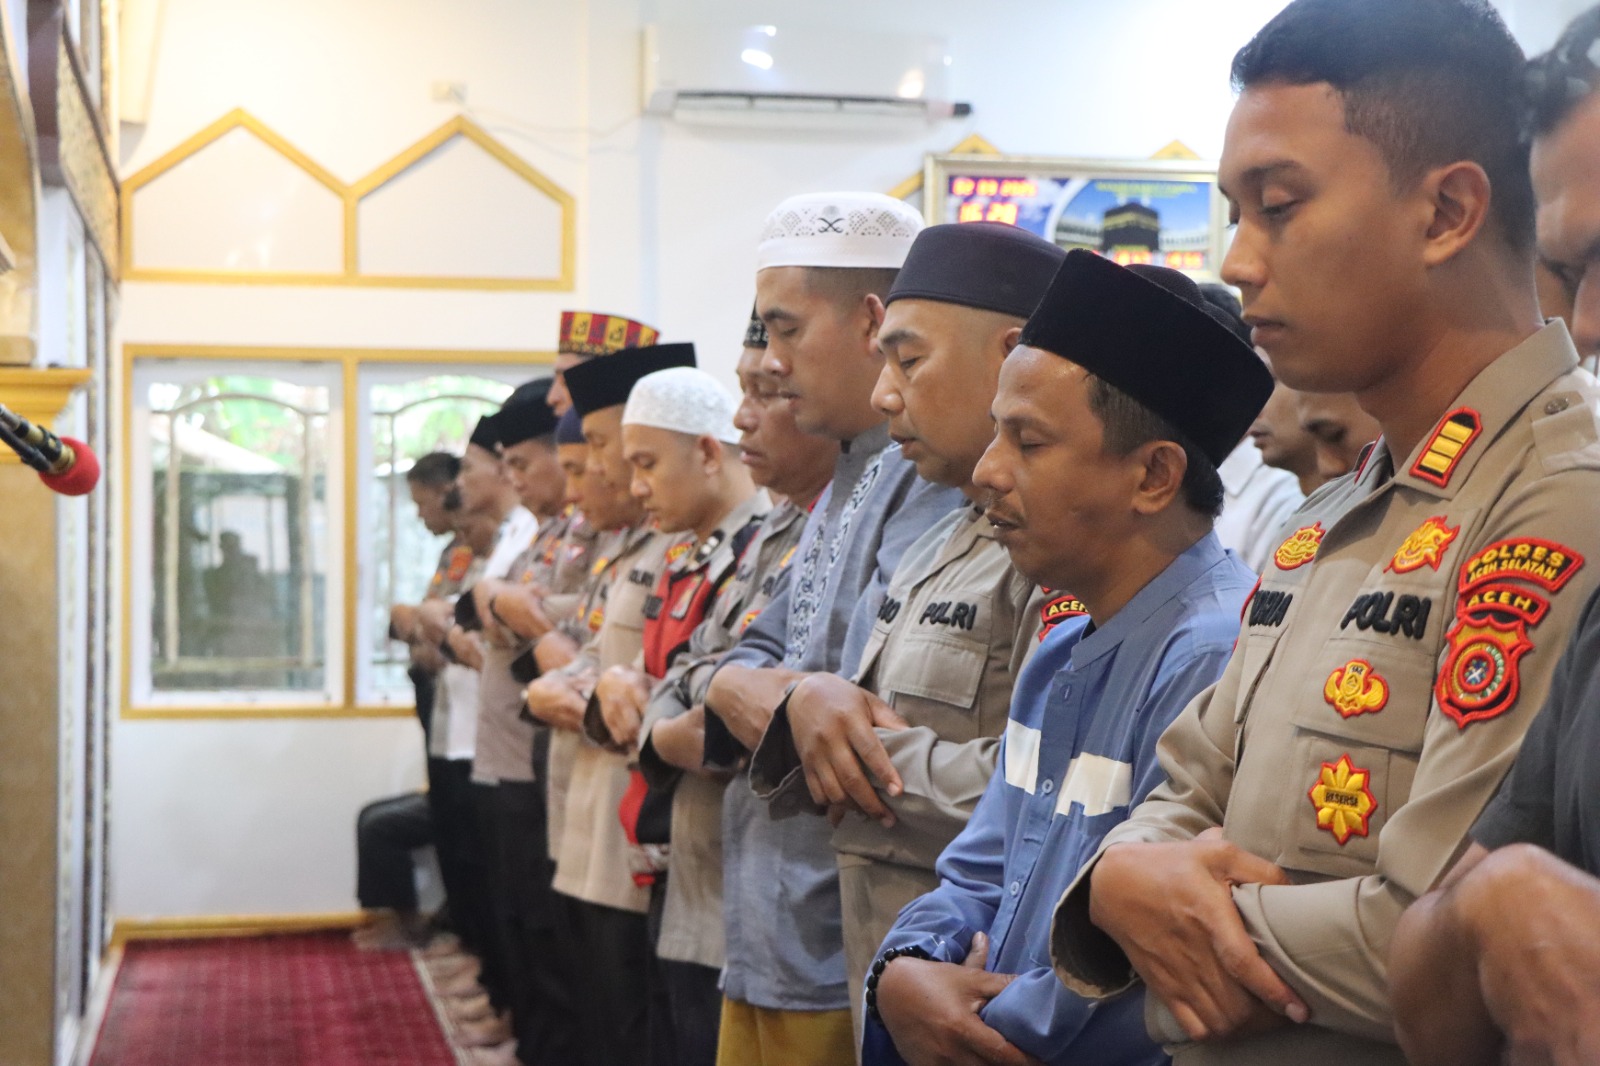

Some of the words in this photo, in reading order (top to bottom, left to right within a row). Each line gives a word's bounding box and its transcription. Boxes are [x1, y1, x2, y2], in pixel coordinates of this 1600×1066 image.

[1468, 543, 1565, 573] POLRES
[1469, 561, 1498, 583] ACEH
[1500, 558, 1558, 580] SELATAN
[1467, 590, 1532, 611] ACEH
[919, 601, 978, 631] POLRI
[1341, 591, 1432, 641] POLRI
